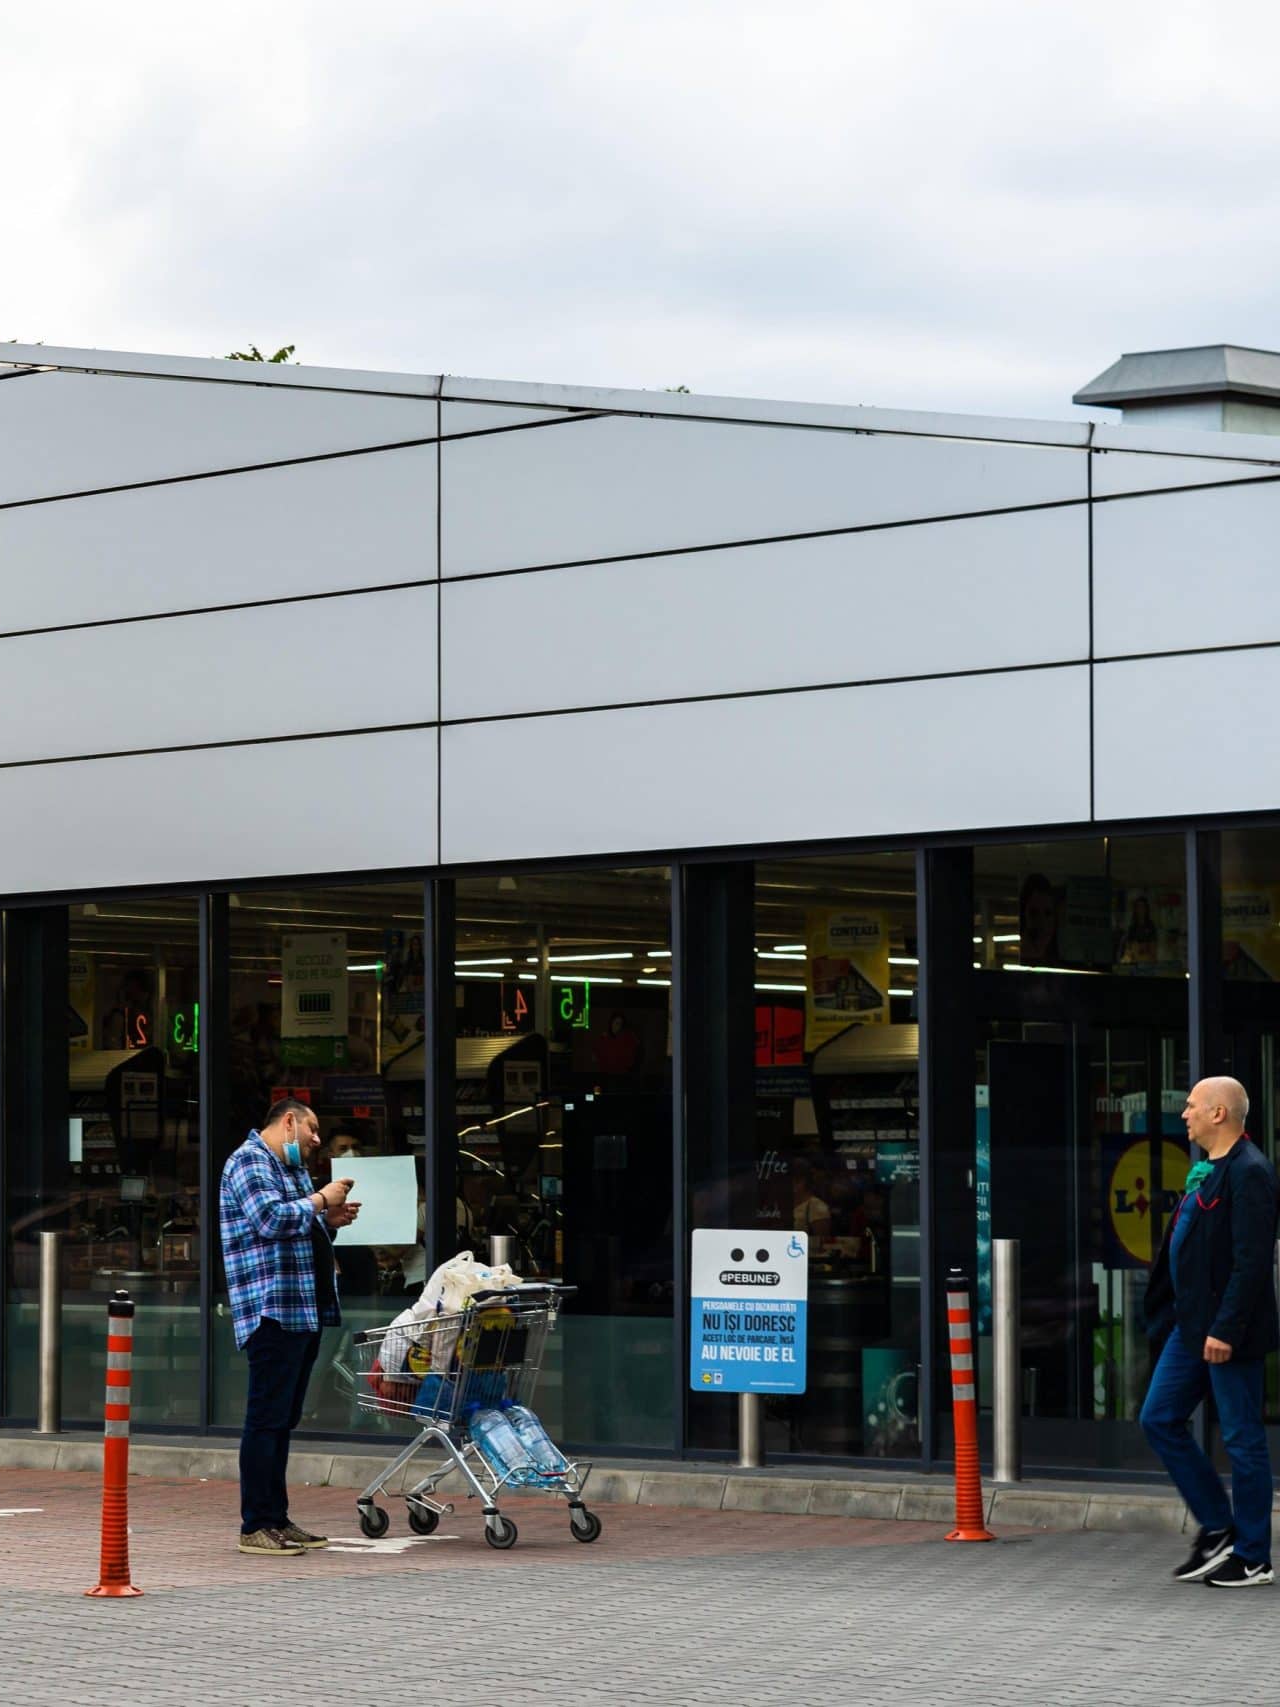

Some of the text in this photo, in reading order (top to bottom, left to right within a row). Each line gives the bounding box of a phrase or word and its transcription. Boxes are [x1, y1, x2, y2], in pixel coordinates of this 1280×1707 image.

[720, 1271, 779, 1284] #PEBUNE?
[703, 1313, 720, 1330] NU
[744, 1314, 795, 1332] DORESC
[702, 1333, 723, 1343] ACEST
[723, 1334, 737, 1343] LOC
[737, 1335, 746, 1343] DE
[701, 1344, 796, 1363] AU NEVOIE DE EL
